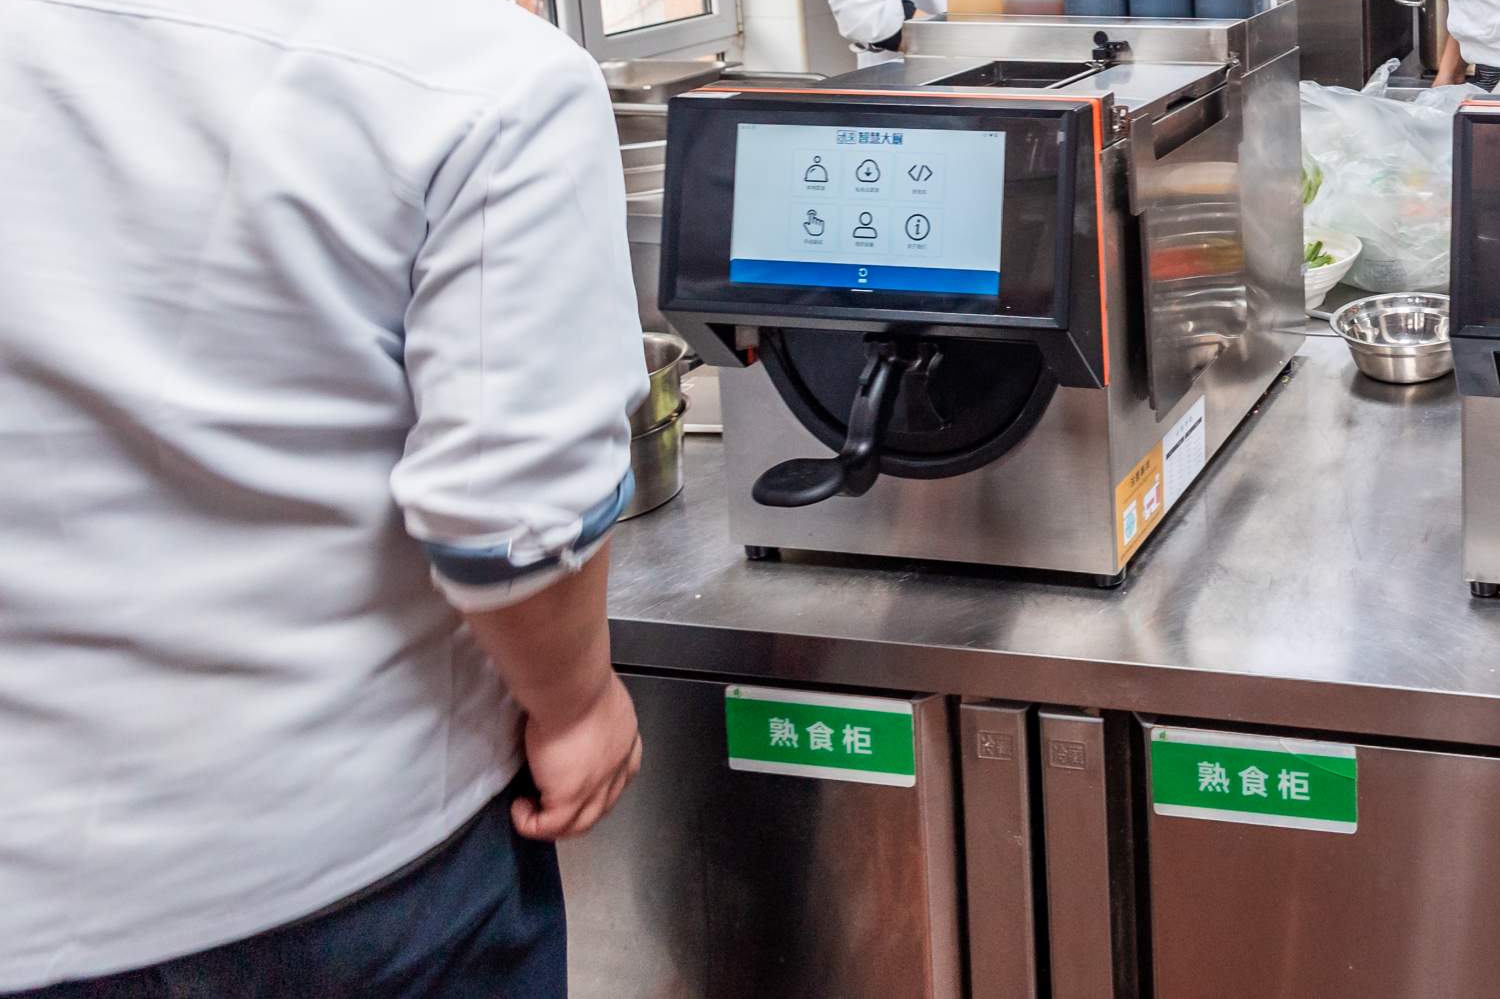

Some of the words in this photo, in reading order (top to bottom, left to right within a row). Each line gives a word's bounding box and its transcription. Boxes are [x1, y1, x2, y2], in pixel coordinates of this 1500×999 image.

[768, 716, 873, 756] 熟食柜
[1197, 760, 1311, 802] 熟食柜
